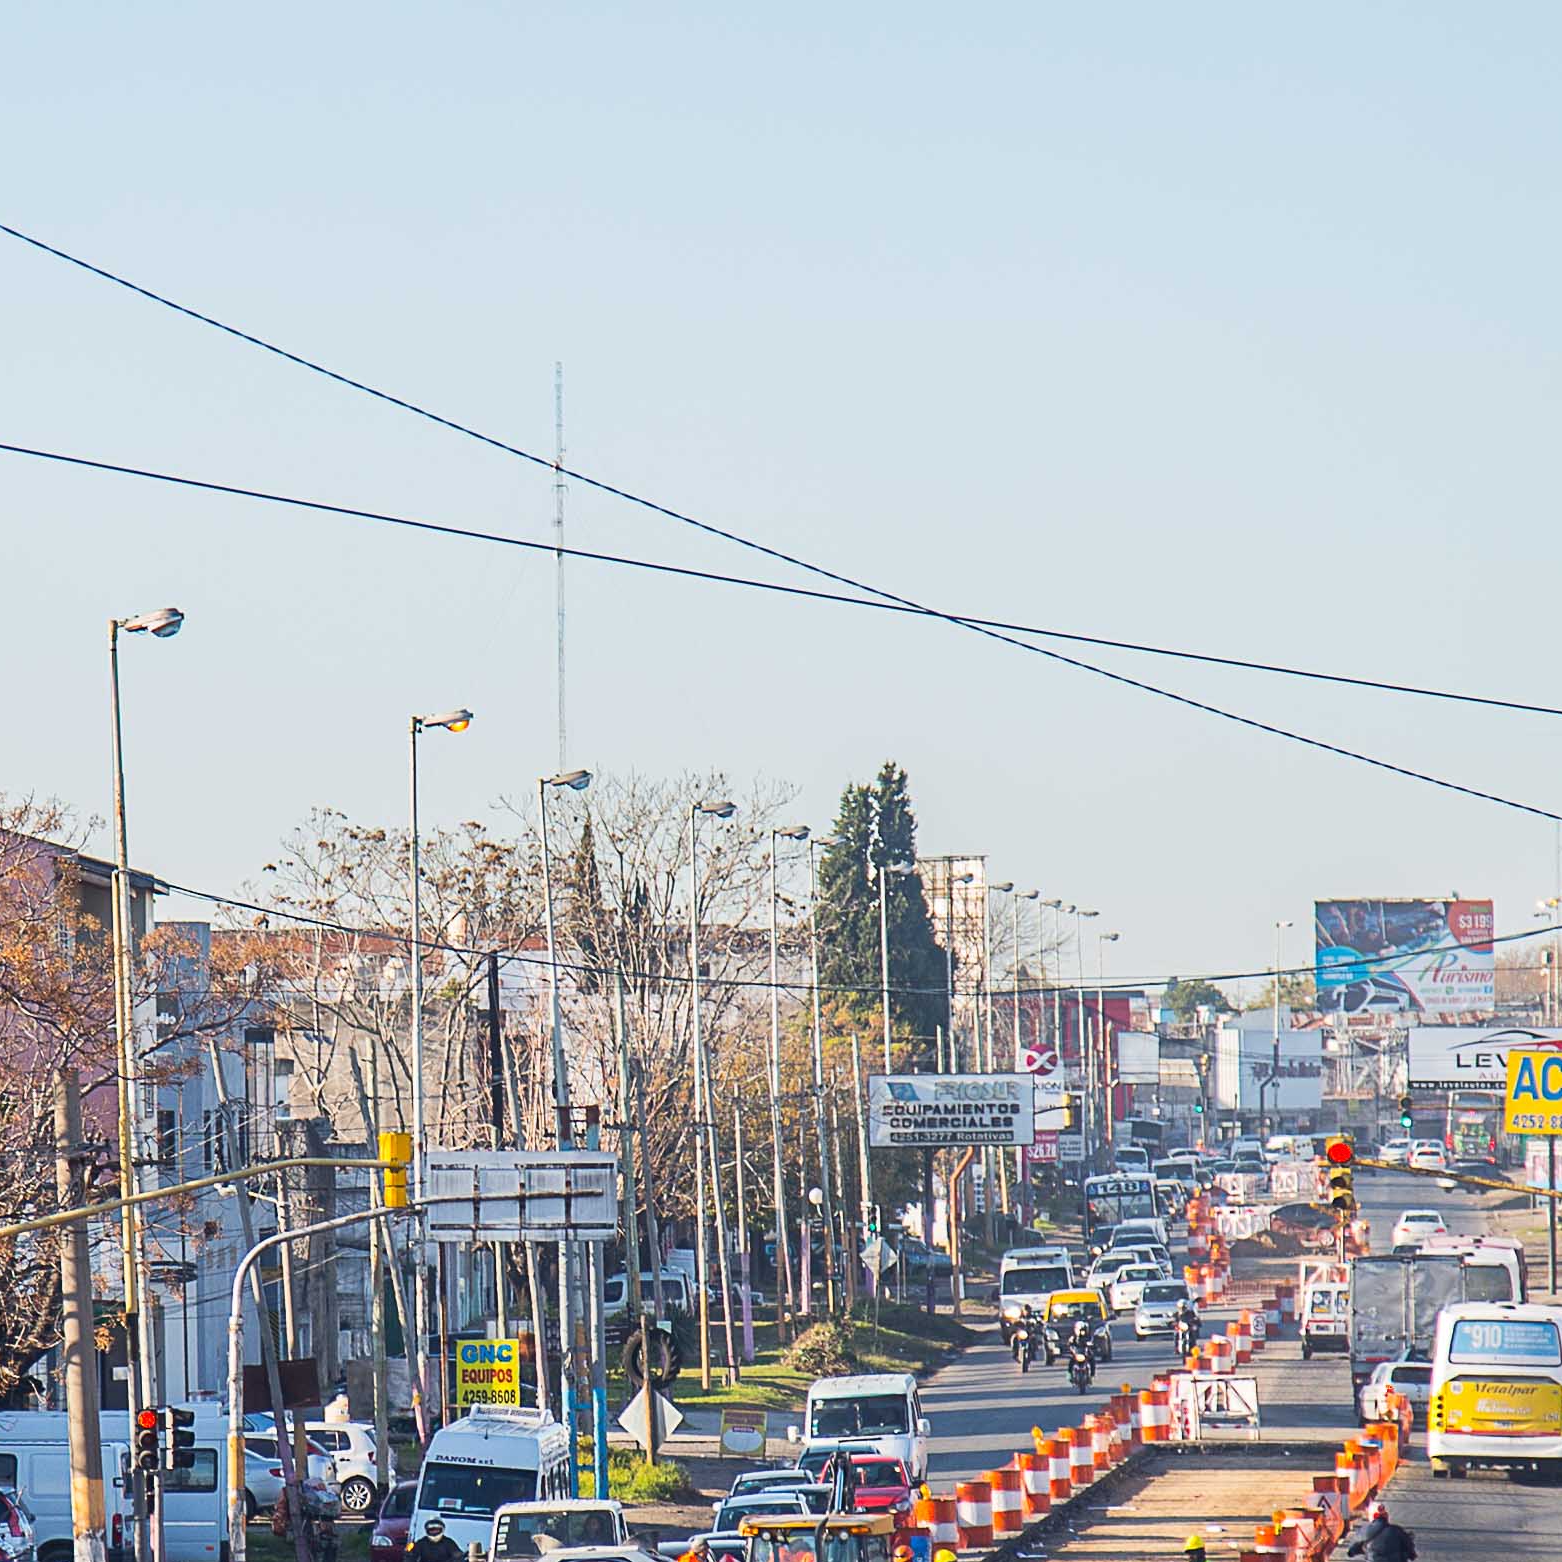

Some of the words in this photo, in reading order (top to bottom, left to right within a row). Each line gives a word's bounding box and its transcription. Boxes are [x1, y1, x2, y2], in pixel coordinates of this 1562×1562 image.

[882, 1103, 1021, 1116] EQUIPAMIENTOS
[890, 1116, 1014, 1129] COMERCIALES
[956, 1131, 1013, 1141] Rotativas
[461, 1344, 513, 1364] GNC
[461, 1368, 513, 1385] EQUIPOS
[462, 1389, 516, 1404] 4259-8608
